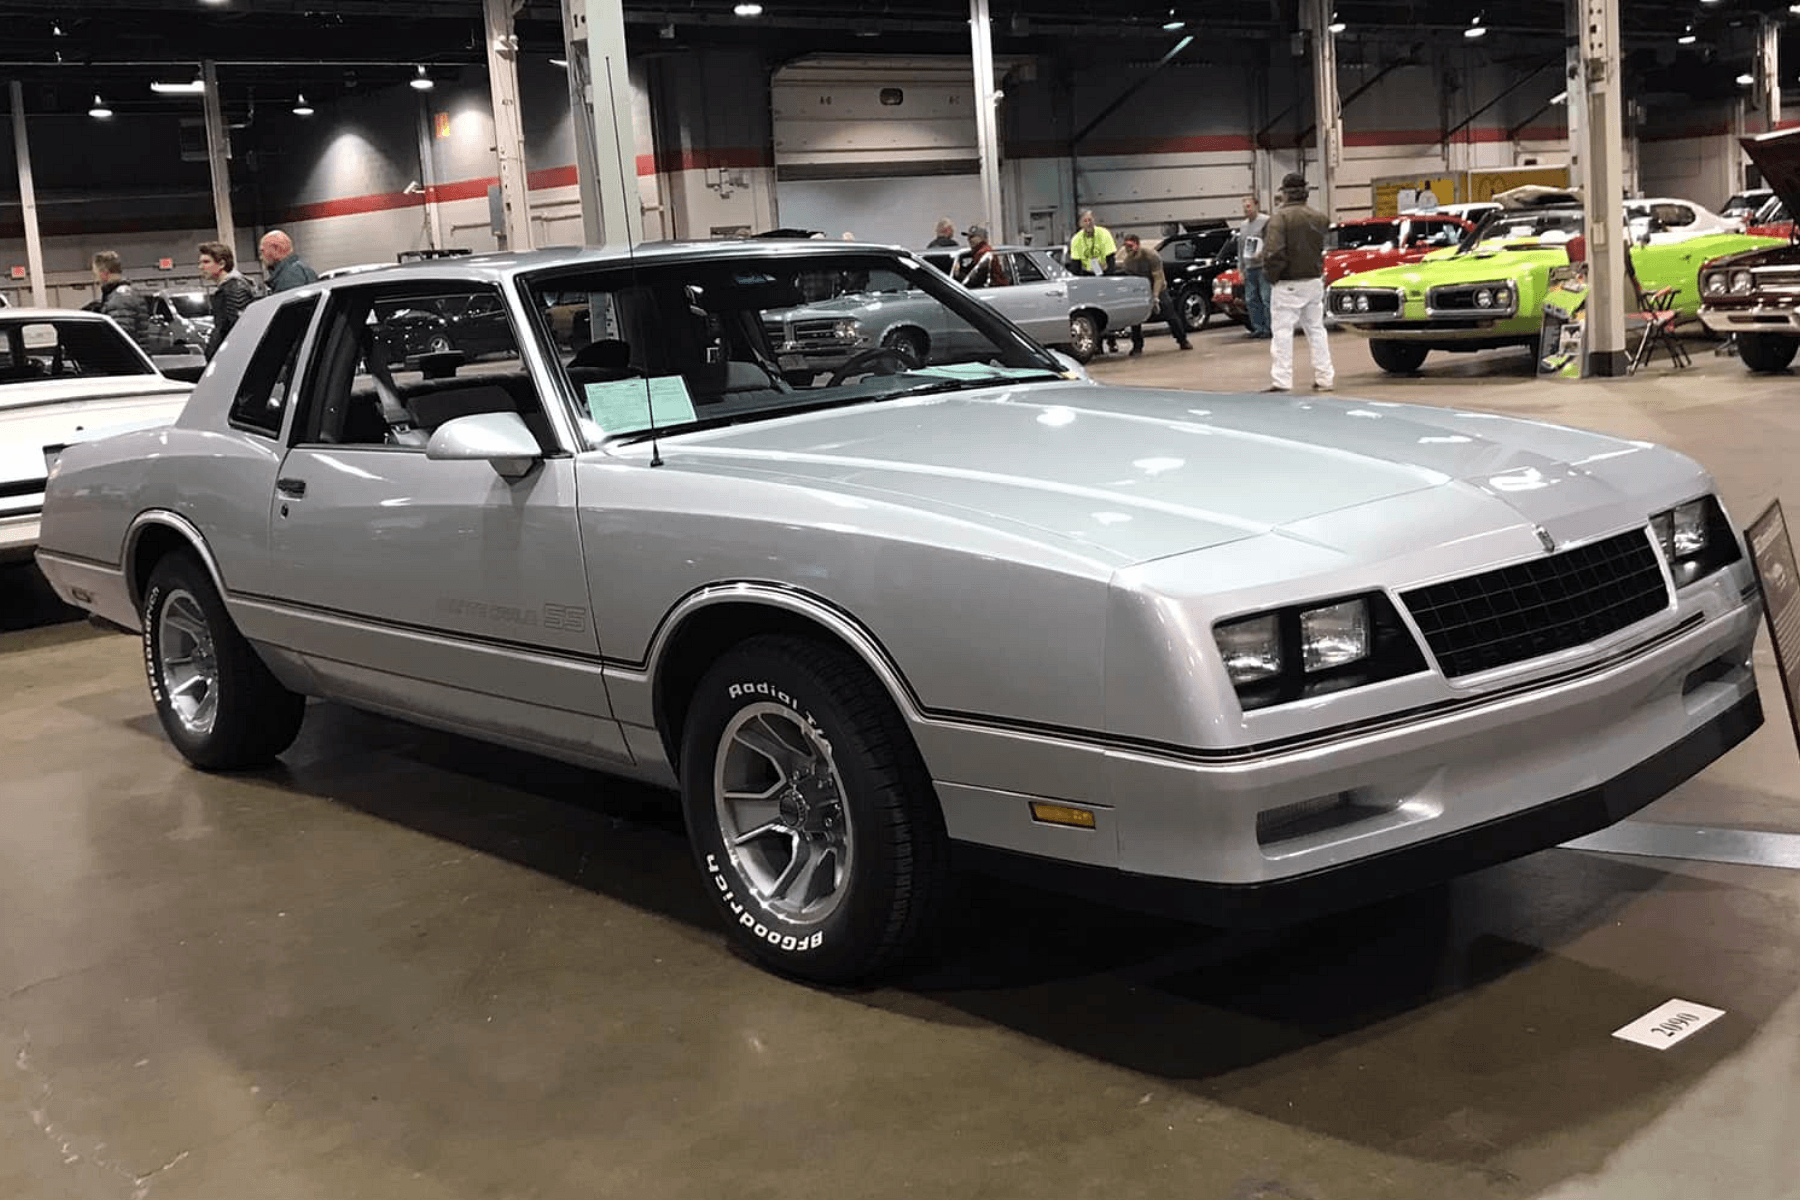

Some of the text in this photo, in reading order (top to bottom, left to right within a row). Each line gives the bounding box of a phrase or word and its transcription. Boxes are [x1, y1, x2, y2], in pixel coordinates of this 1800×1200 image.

[544, 602, 587, 633] SS
[728, 682, 798, 710] Radial
[706, 854, 823, 951] BFGoodrich
[1650, 1013, 1700, 1037] 2090
